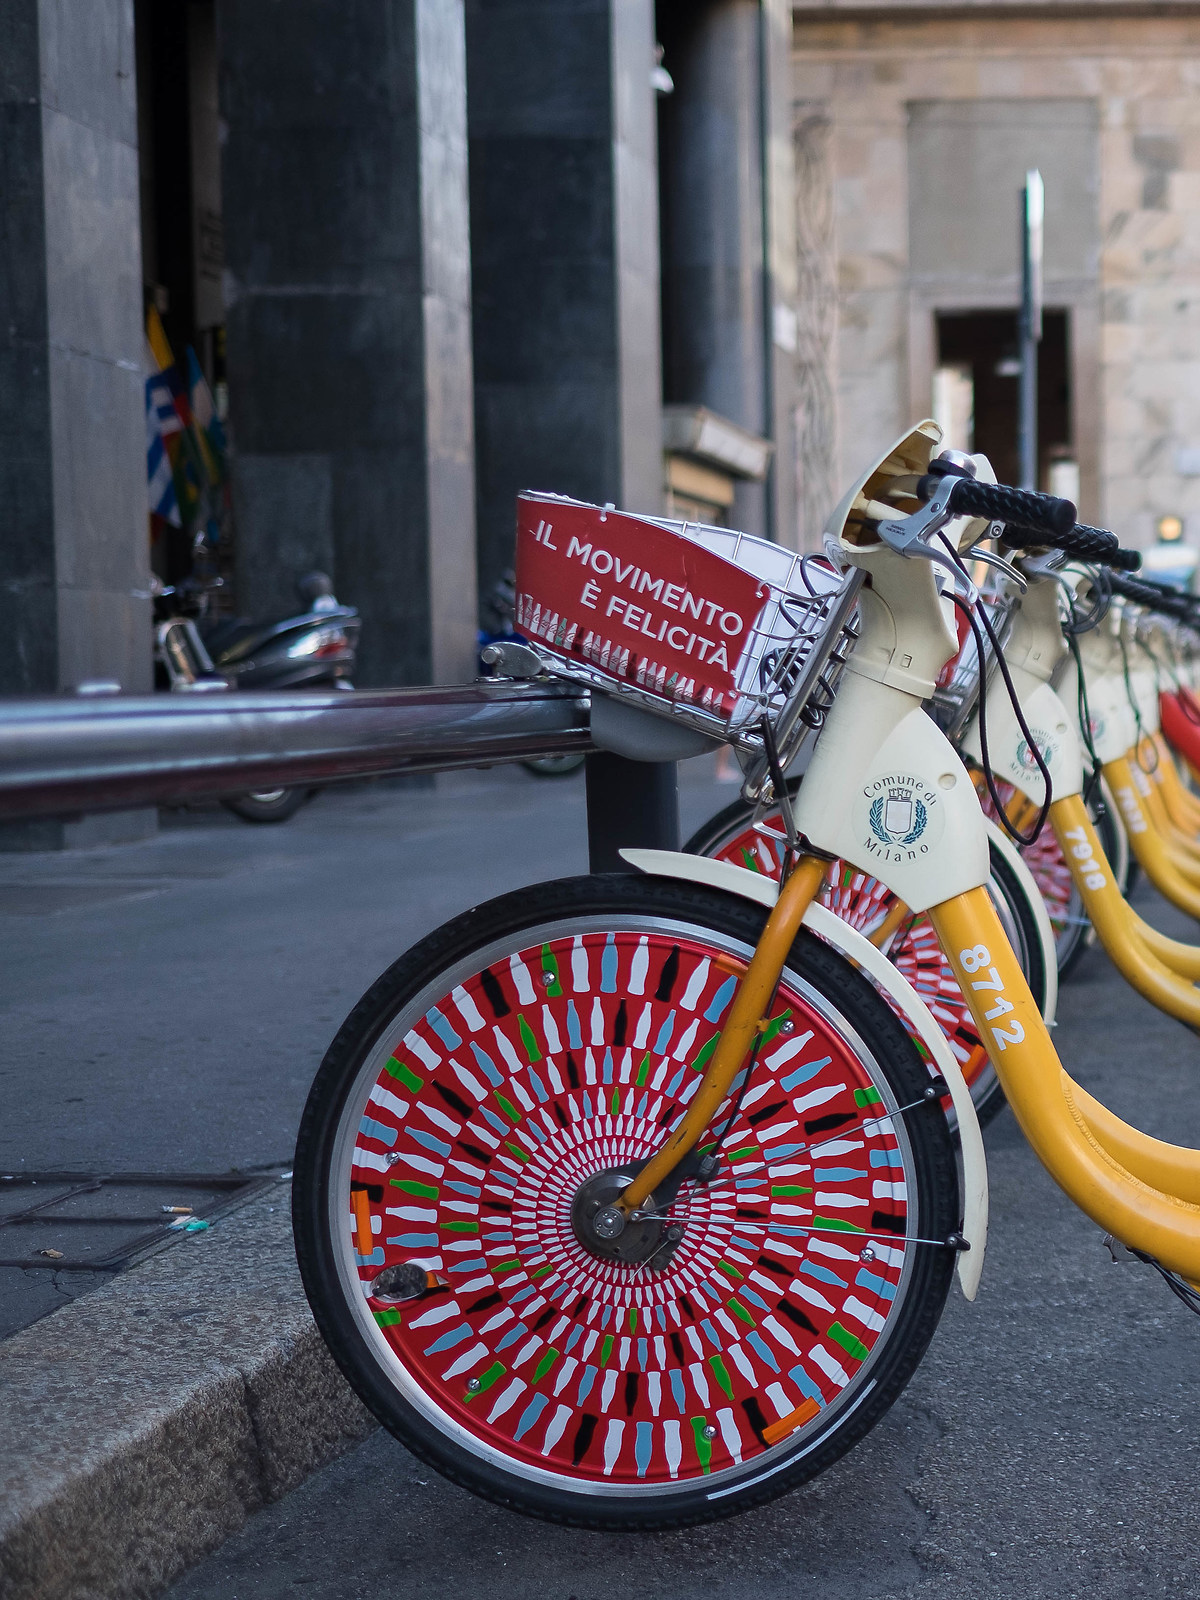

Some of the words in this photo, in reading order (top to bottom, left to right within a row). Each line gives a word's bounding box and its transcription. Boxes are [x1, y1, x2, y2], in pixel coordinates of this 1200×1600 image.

[535, 520, 558, 551] IL
[565, 536, 745, 637] MOVIMENTO
[580, 578, 602, 610] È
[605, 595, 737, 678] FELICITÀ.
[863, 775, 924, 799] Comune
[924, 792, 937, 807] di
[863, 837, 929, 862] Milano
[1064, 825, 1107, 891] 7918
[959, 943, 1026, 1051] 8712
